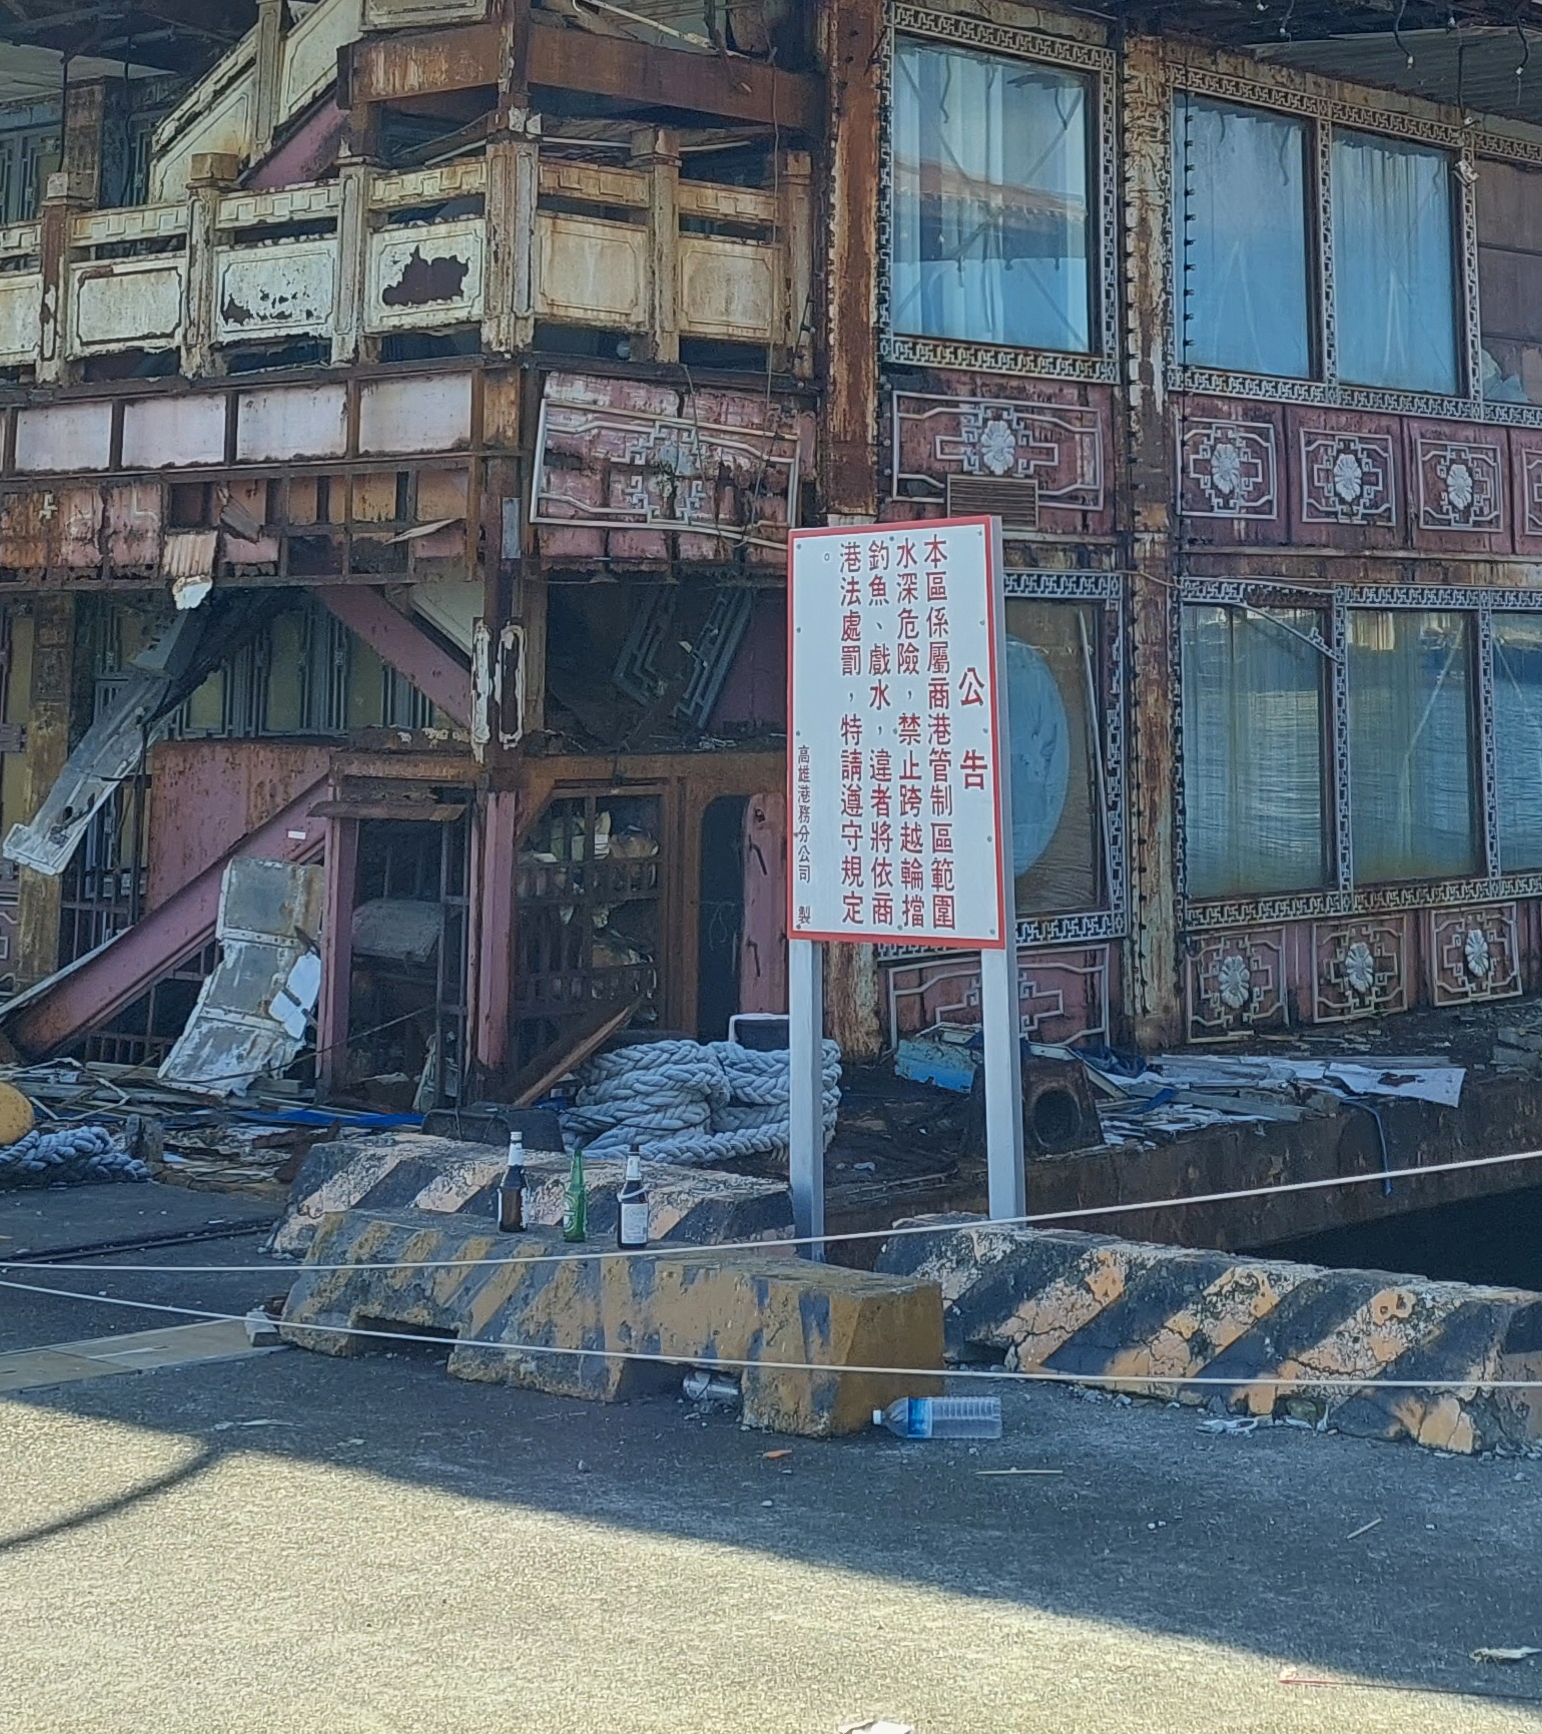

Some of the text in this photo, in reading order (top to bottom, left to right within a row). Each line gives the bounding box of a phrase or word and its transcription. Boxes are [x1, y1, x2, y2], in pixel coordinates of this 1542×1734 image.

[797, 744, 811, 925] 高雄港務分公司 製
[896, 537, 925, 928] 水深危險，禁止跨越輪擋
[924, 533, 956, 931] 本區係屬商港管制區範圍
[958, 667, 988, 791] 公告
